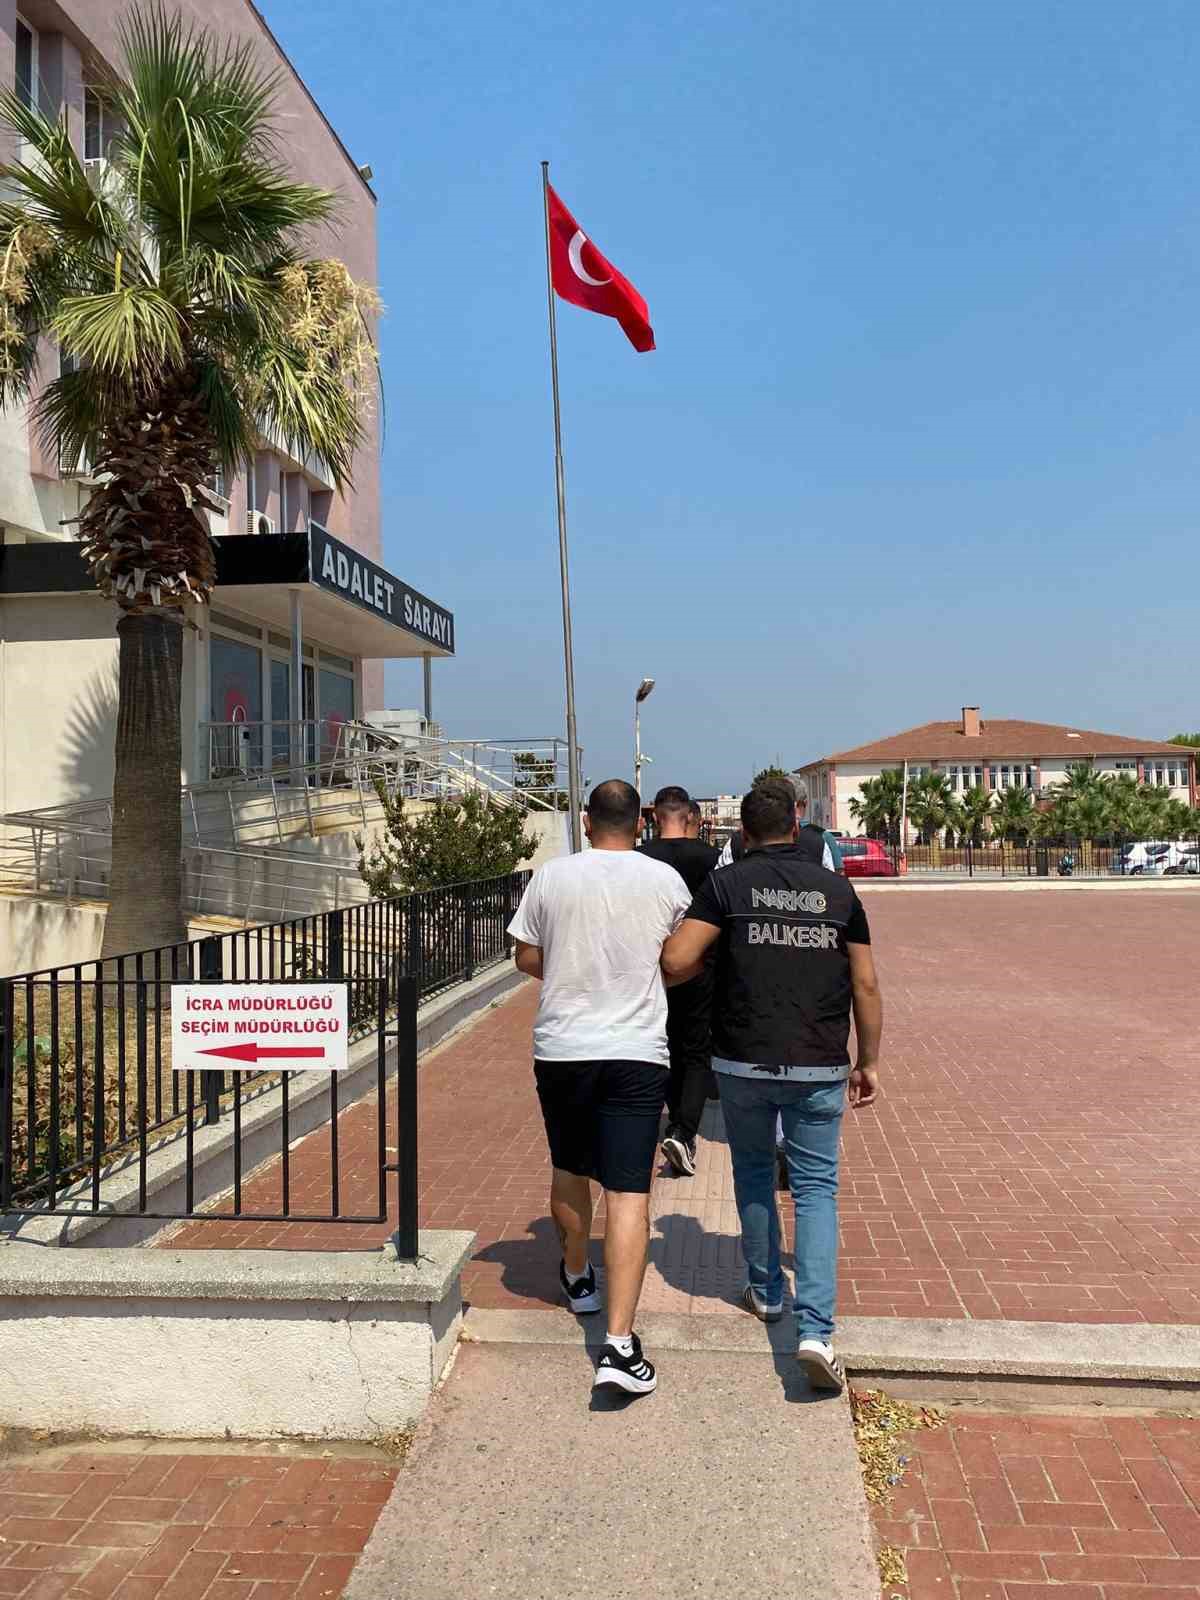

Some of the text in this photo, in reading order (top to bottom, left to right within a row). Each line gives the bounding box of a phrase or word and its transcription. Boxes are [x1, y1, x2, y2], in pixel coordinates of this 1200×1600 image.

[322, 543, 451, 646] ADALET SARAYI
[751, 887, 827, 913] NARKO
[748, 923, 838, 949] BALIKESİR
[186, 995, 333, 1011] İCRA MÜDÜRLÜĞÜ
[181, 1018, 339, 1036] SEÇİM MÜDÜRLÜĞÜ
